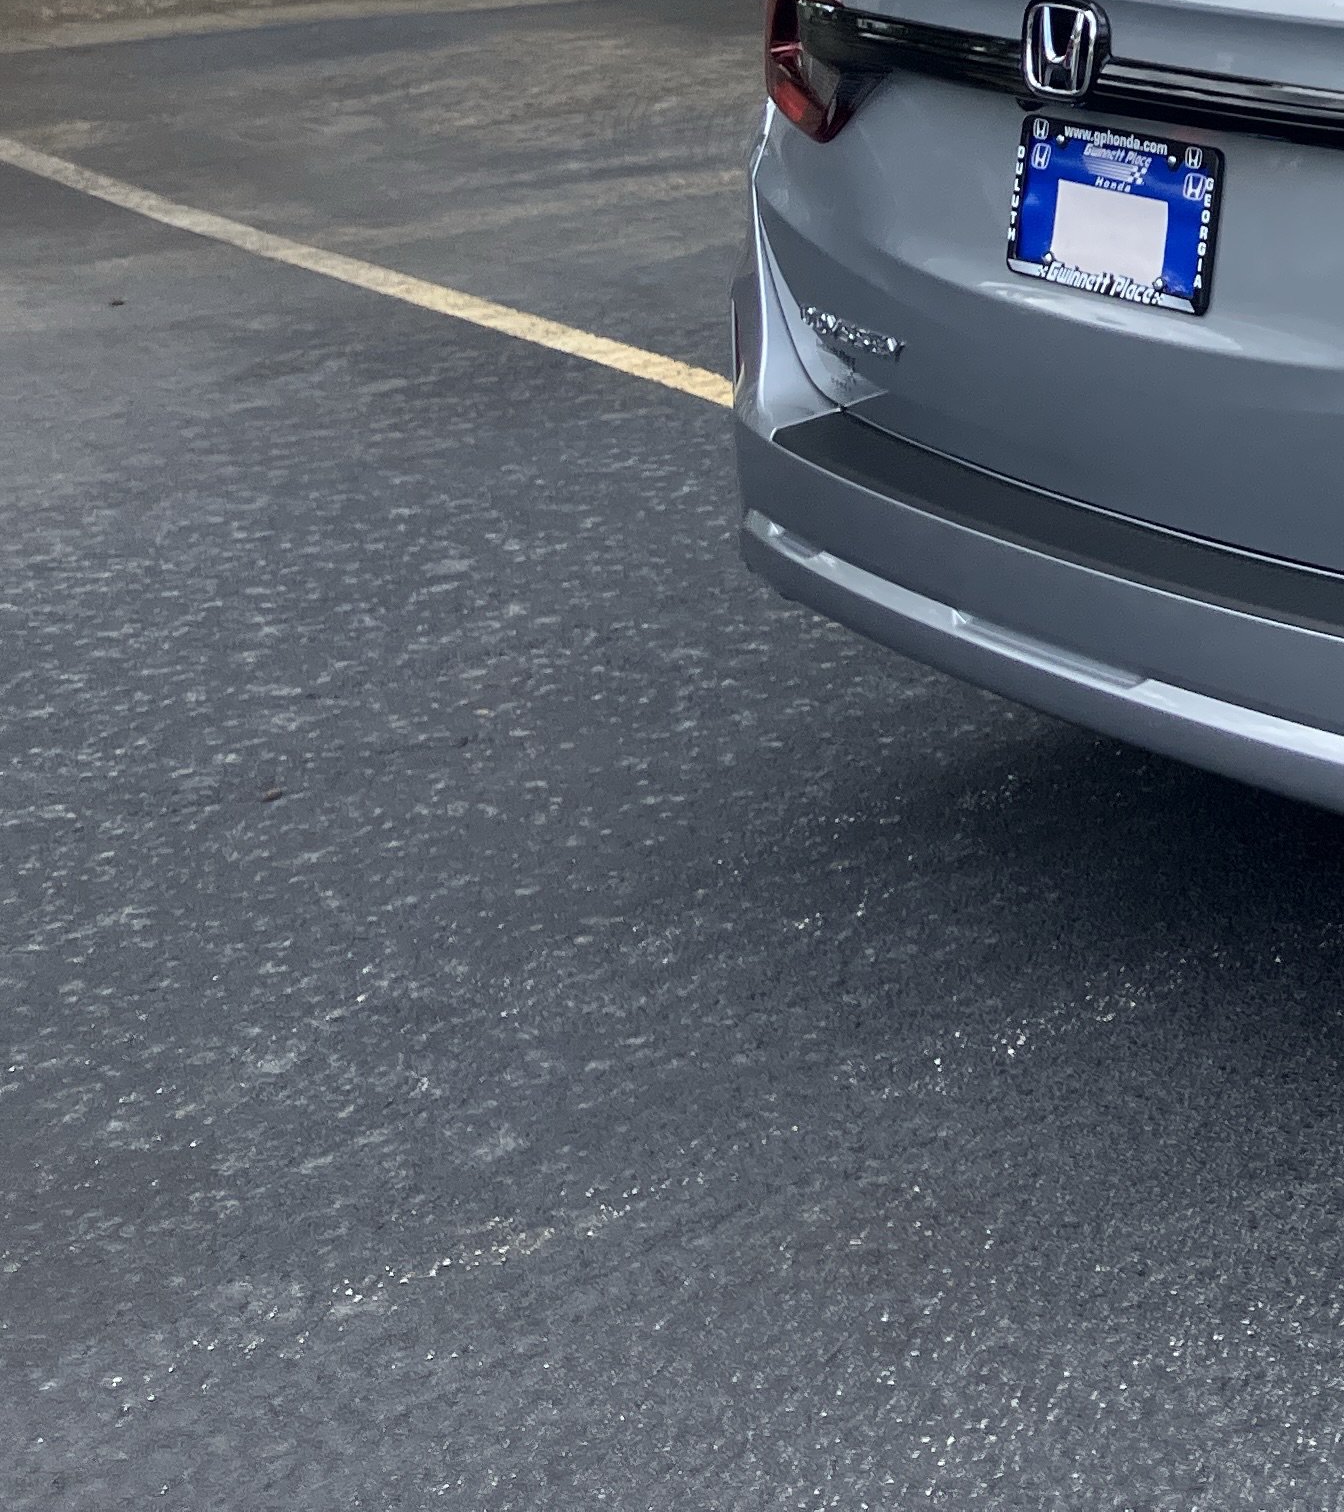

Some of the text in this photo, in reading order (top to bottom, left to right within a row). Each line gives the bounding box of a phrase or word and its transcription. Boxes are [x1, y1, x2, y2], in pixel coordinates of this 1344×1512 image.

[1064, 124, 1169, 156] www.gphonda.com
[1083, 143, 1152, 168] Gwinnett Place
[1007, 145, 1026, 241] DULUTH
[1094, 176, 1132, 193] Honda
[1192, 177, 1215, 289] GEORGIA
[1046, 261, 1156, 304] Gwinnett Place
